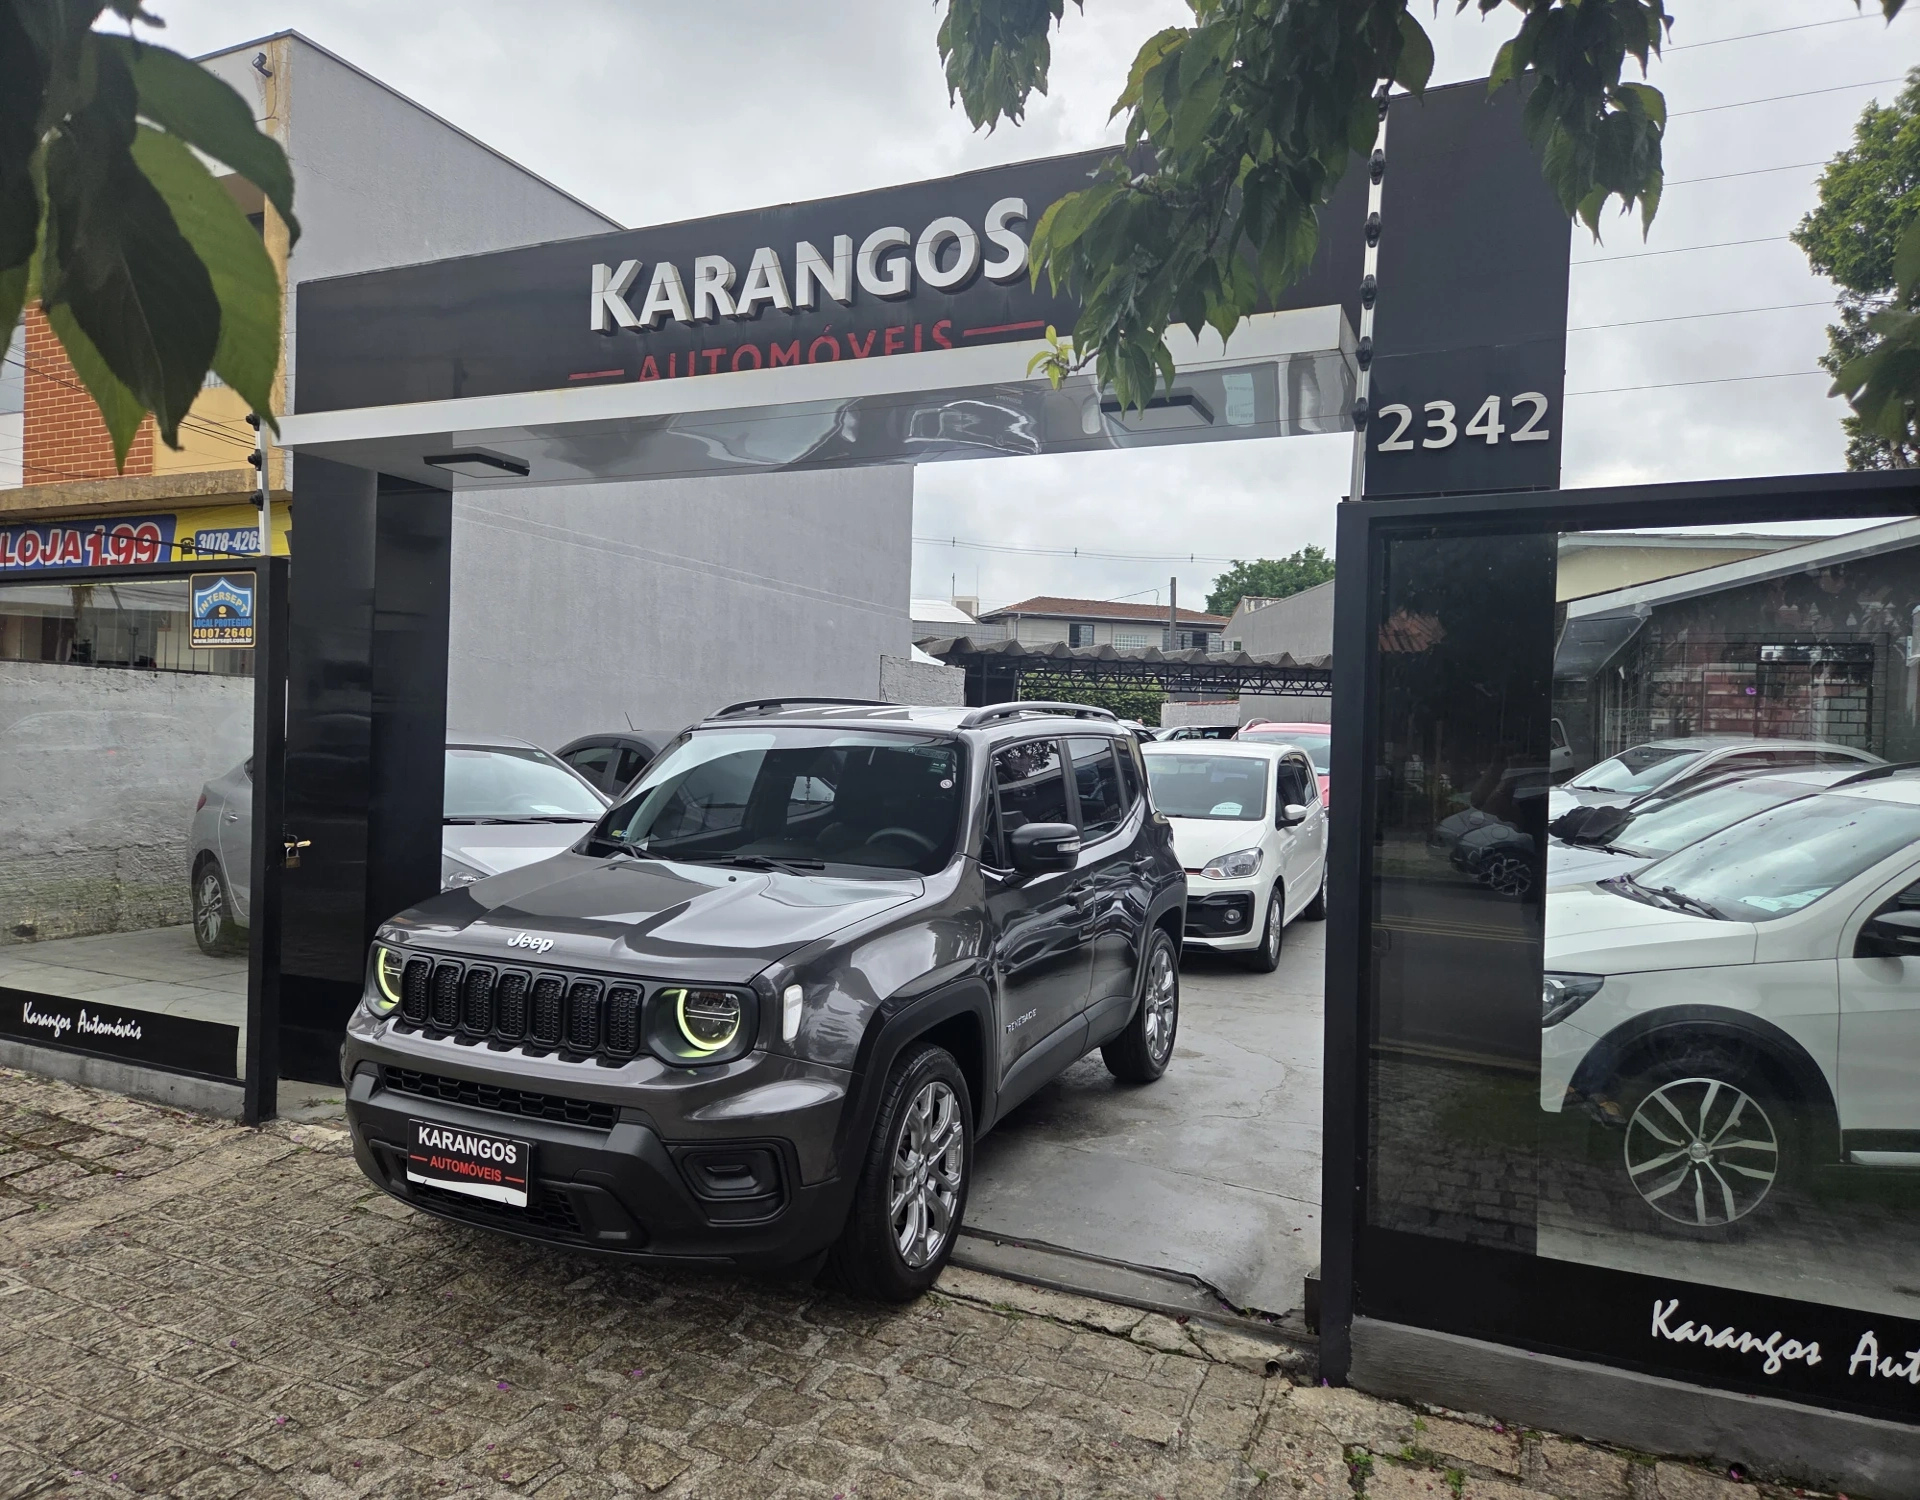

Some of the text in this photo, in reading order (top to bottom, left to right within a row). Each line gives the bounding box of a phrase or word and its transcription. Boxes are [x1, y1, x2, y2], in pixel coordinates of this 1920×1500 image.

[590, 197, 1029, 335] KARANGOS
[638, 319, 953, 382] AUTOMÓVEIS
[1377, 391, 1550, 452] 2342
[0, 528, 83, 567] LOJA
[198, 591, 248, 614] INTERSEPT
[193, 617, 252, 628] LOCAL PROTEGIDO
[193, 627, 252, 638] 4007-2640
[507, 932, 555, 954] Jeep
[23, 1001, 142, 1040] Karangos Automóveis
[417, 1126, 518, 1164] KARANGOS
[429, 1155, 503, 1182] AUTOMÓVEIS
[1651, 1298, 1822, 1375] Karangos
